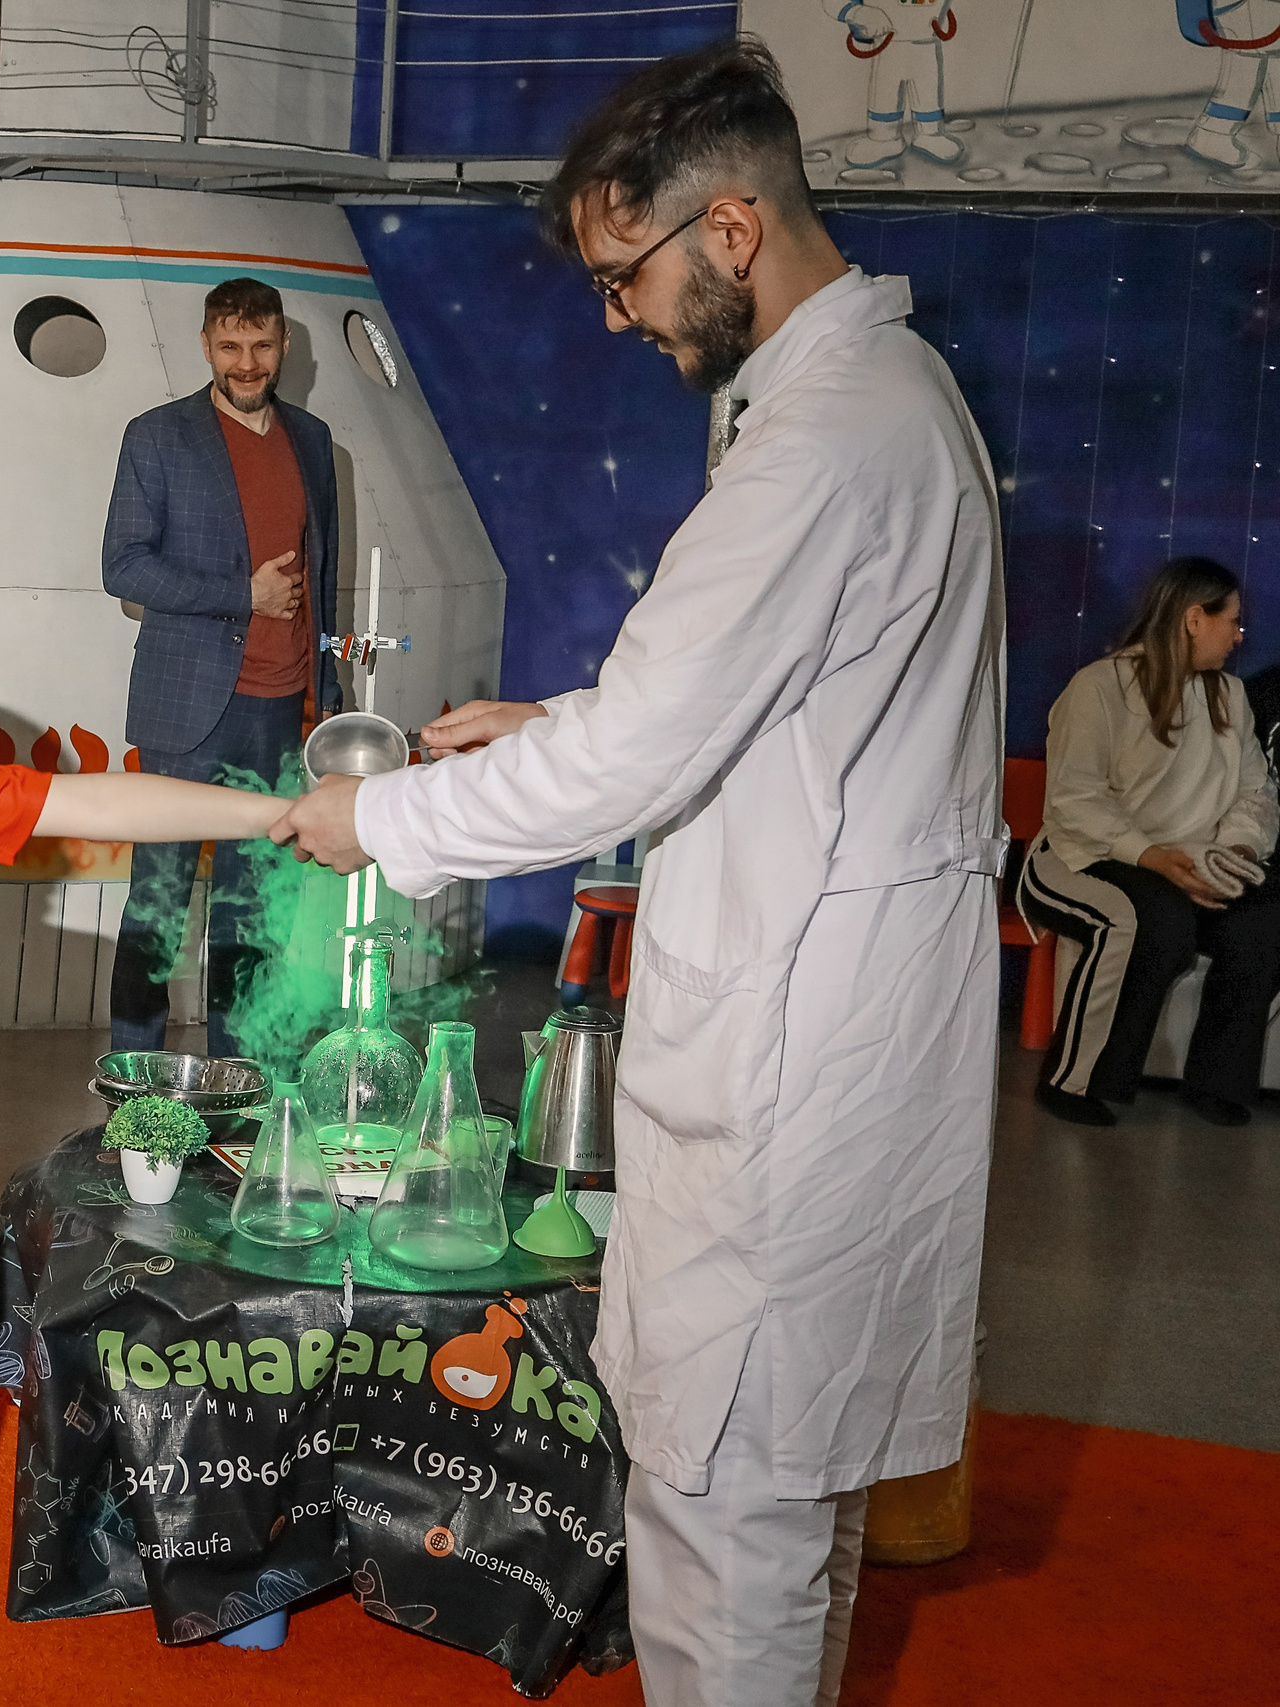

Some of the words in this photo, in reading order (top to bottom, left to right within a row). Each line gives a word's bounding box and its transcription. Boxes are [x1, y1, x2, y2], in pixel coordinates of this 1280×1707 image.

[113, 1398, 254, 1424] КАДЕМИЯ
[429, 1401, 589, 1469] БЕЗУМСТВ
[123, 1455, 190, 1496] 347)
[197, 1429, 331, 1489] 298-66-66
[370, 1435, 406, 1462] +7
[413, 1442, 498, 1500] (963)
[505, 1481, 626, 1567] 136-66-66
